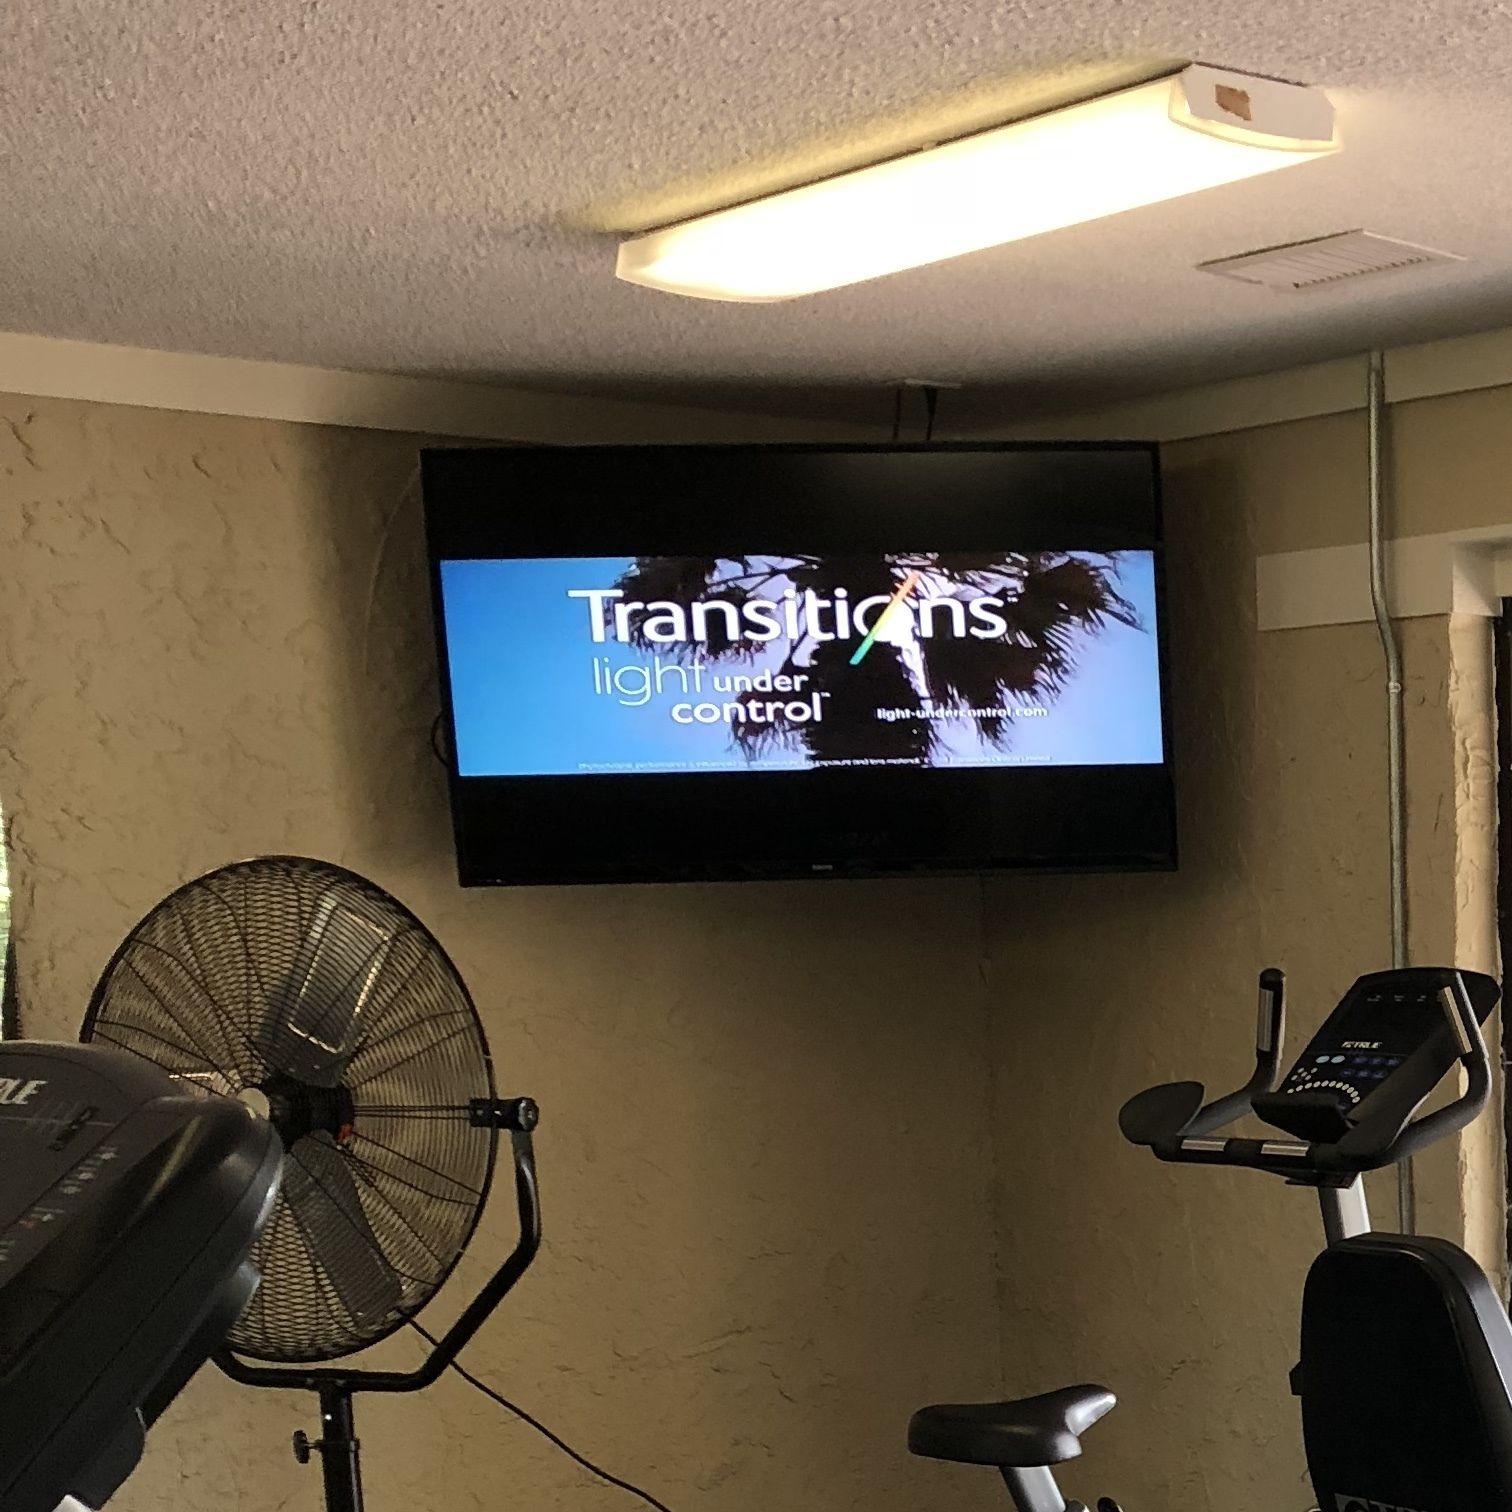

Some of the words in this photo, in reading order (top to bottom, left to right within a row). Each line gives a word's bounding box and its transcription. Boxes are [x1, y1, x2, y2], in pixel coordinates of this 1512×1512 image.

[567, 586, 1008, 644] Transitions
[592, 656, 706, 706] light
[712, 670, 808, 693] under
